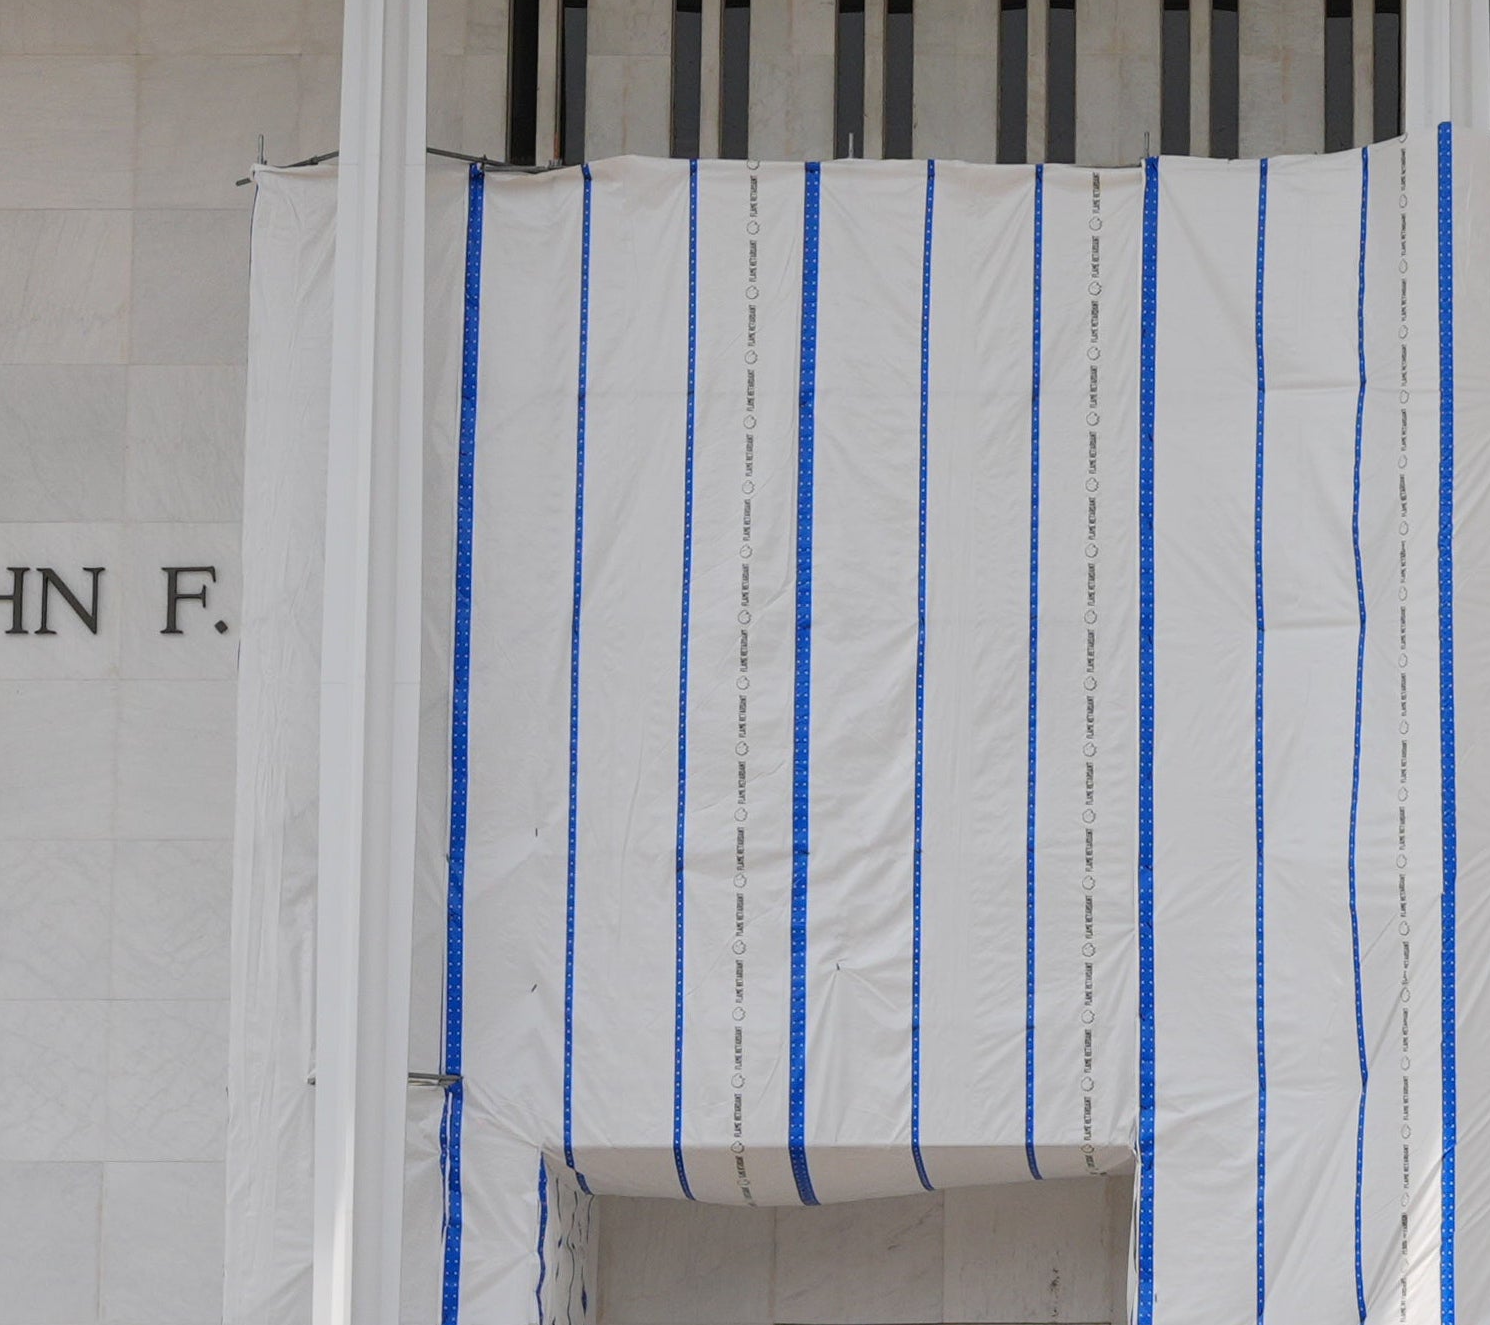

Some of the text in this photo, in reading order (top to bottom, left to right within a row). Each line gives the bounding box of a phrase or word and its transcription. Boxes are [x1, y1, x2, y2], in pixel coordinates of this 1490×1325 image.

[749, 203, 757, 218] FLAME
[1092, 200, 1100, 213] FLAME
[748, 268, 756, 282] FLAME
[1091, 264, 1099, 278] FLAME
[746, 398, 754, 412] FLAME
[1089, 394, 1097, 409] FLAME
[745, 462, 753, 477] FLAME
[1088, 460, 1096, 474] FLAME
[742, 527, 750, 541] FLAME
[1088, 526, 1096, 540] FLAME
[160, 566, 228, 634] F.
[741, 592, 749, 607] FLAME
[1087, 592, 1095, 606] FLAME
[738, 723, 746, 738] FLAME
[1086, 724, 1094, 739] FLAME
[737, 790, 745, 804] FLAME
[1085, 791, 1093, 805] FLAME
[736, 856, 744, 871] FLAME
[1085, 857, 1093, 872] FLAME
[735, 922, 743, 937] FLAME
[1085, 924, 1093, 939] FLAME
[734, 1055, 742, 1070] FLAME
[1083, 1058, 1091, 1073] FLAME
[733, 1123, 741, 1138] FLAME
[1083, 1126, 1091, 1141] FLAME
